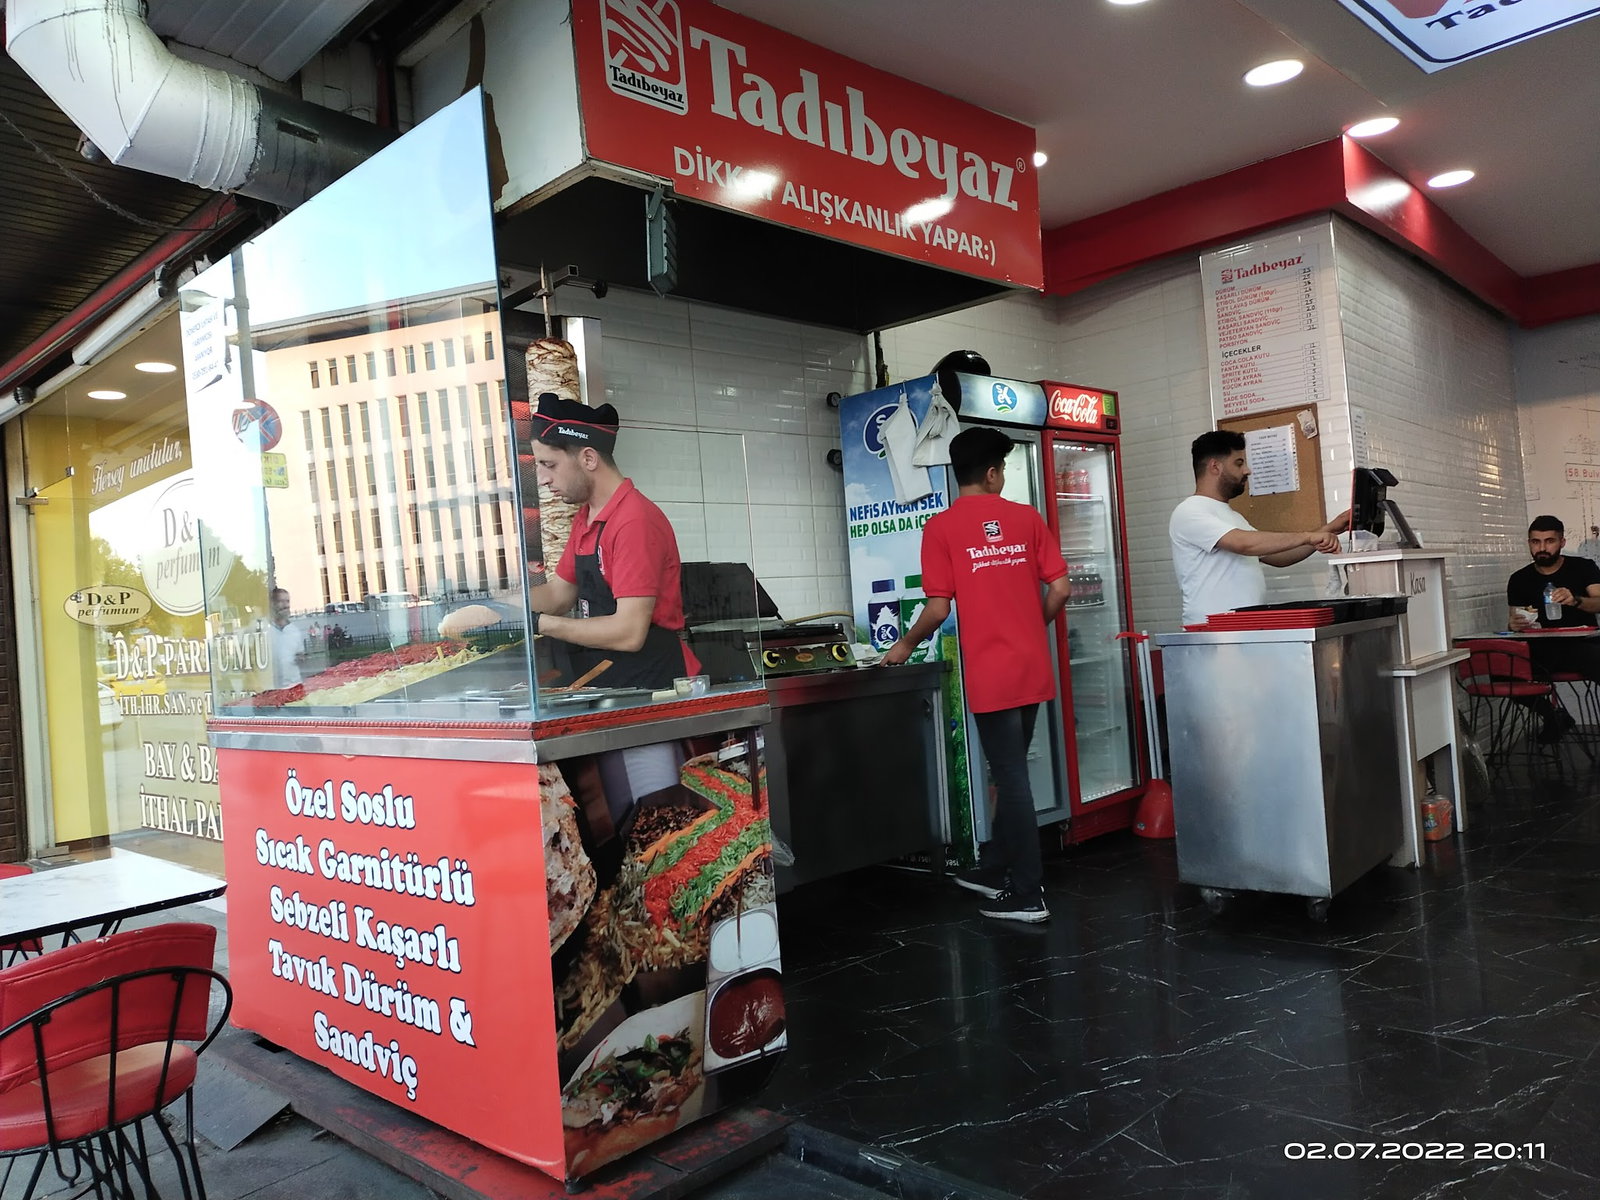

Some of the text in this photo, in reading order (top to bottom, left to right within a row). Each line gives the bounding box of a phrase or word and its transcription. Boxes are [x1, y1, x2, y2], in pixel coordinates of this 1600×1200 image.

[1424, 0, 1522, 30] Ta
[609, 64, 685, 104] Tadıbeyaz
[689, 25, 1019, 211] Tadıbeyaz
[782, 181, 917, 242] ALIŞKANLIK
[1234, 255, 1303, 280] Tadıbeyaz
[1222, 344, 1261, 359] İÇECEKLER
[1568, 468, 1579, 477] 58
[850, 523, 869, 539] HEP
[871, 519, 897, 535] OLSA
[898, 516, 913, 532] DA
[966, 544, 1027, 559] Tadıbeyaz
[86, 592, 132, 606] D&P
[1410, 571, 1426, 596] Kasa
[143, 741, 177, 780] BAY
[180, 741, 196, 783] &
[139, 783, 194, 837] İTHAL
[285, 767, 416, 829] Özel Soslu
[255, 827, 476, 907] Sıcak Garnitürlü
[269, 884, 462, 974] Sebzeli Kaşarlı
[268, 938, 478, 1049] Tavuk Dürüm &
[313, 1009, 419, 1101] Sandviç
